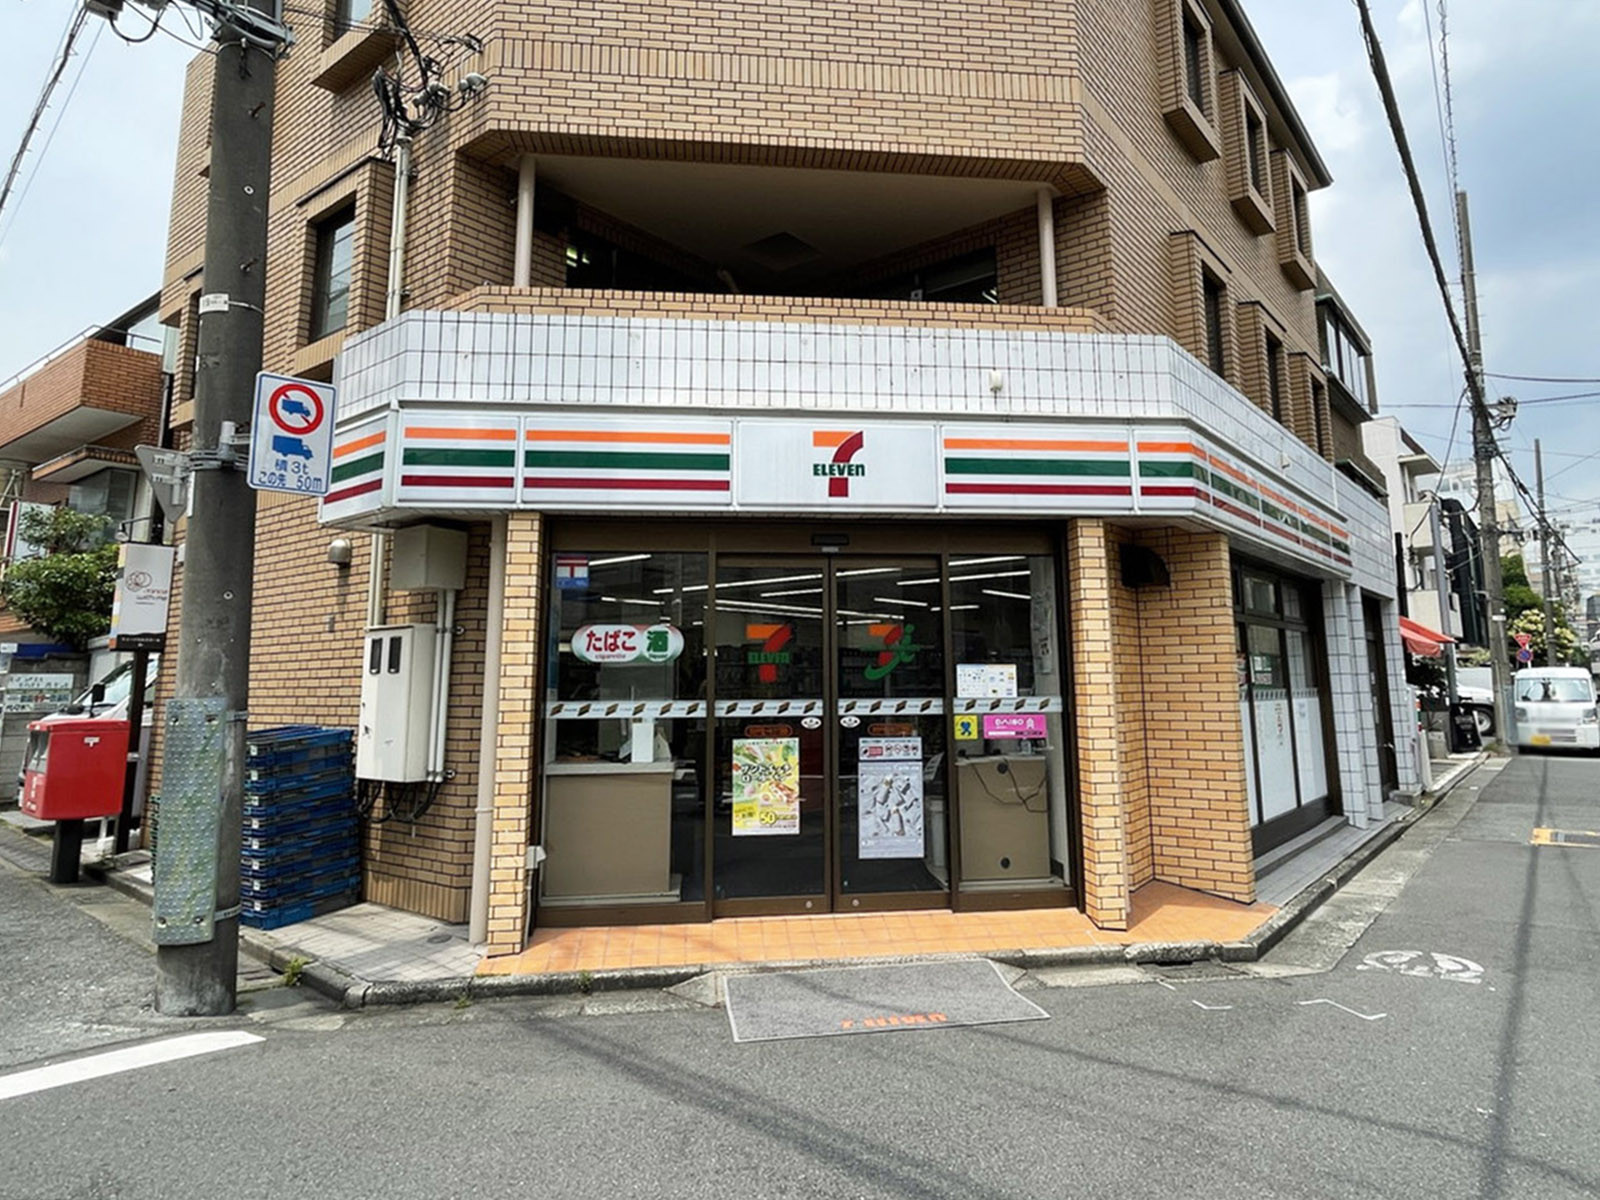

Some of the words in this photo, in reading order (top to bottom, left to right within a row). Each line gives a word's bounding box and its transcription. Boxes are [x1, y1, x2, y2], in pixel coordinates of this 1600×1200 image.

[291, 461, 310, 475] 3t
[812, 430, 863, 498] 7
[258, 471, 287, 487] この先
[296, 475, 323, 491] 50m
[586, 629, 637, 653] たばこ
